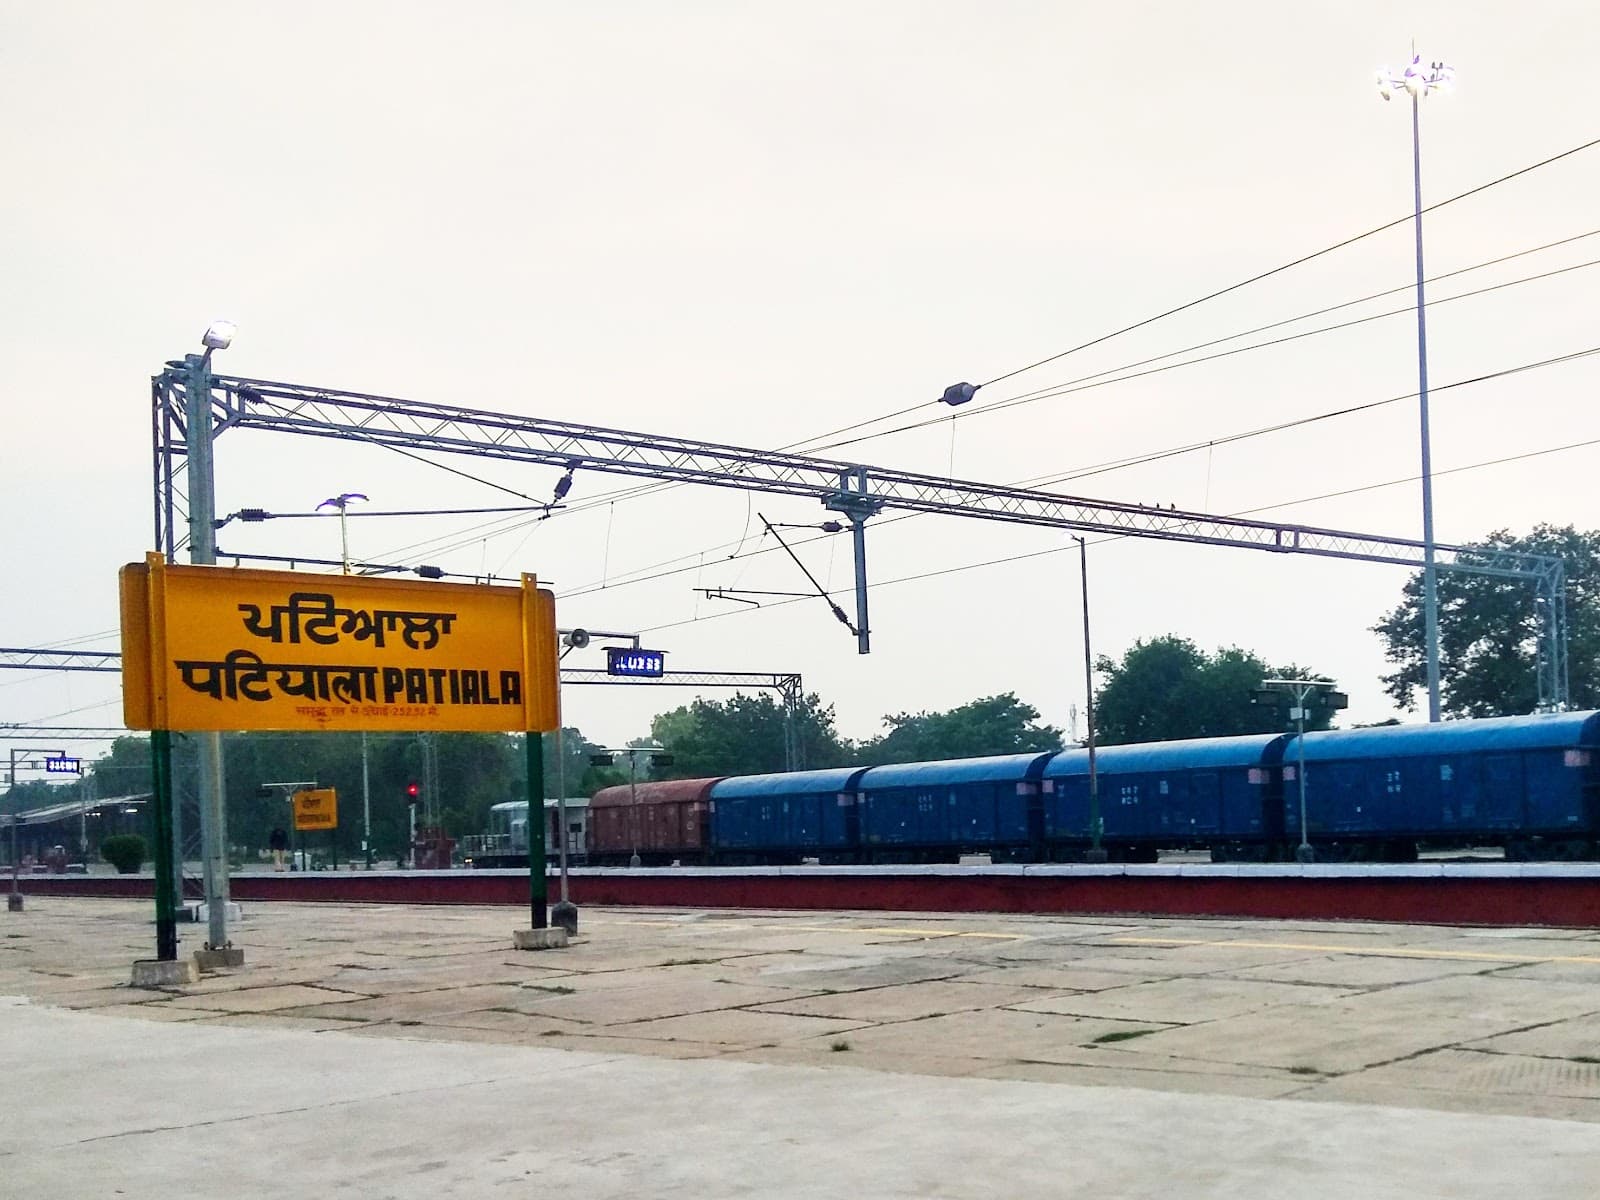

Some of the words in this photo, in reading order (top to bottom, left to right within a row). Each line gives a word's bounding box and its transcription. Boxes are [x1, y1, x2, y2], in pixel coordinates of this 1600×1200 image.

[238, 592, 457, 650] ਪਟਿਆਲਾ
[174, 649, 379, 703] पटियाला
[383, 668, 521, 705] PATIALA
